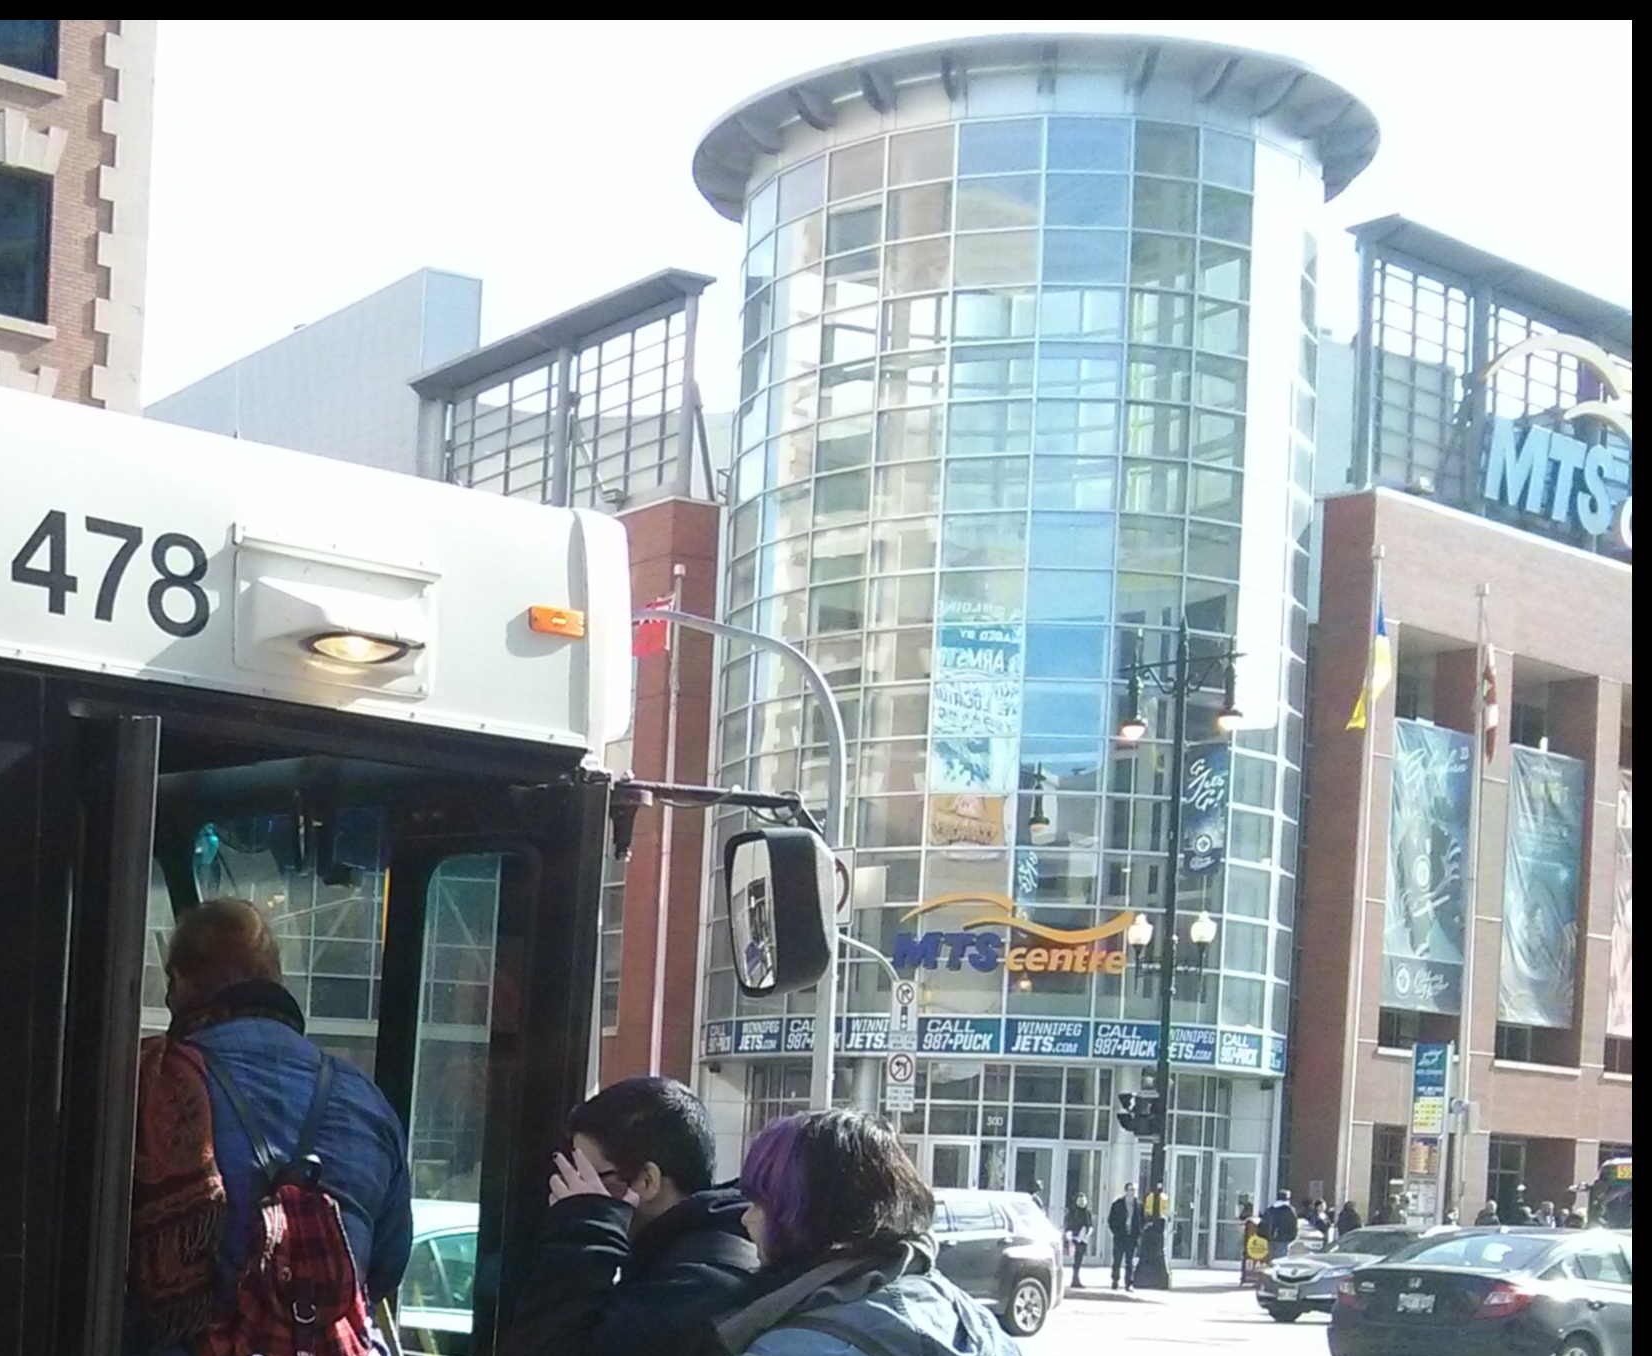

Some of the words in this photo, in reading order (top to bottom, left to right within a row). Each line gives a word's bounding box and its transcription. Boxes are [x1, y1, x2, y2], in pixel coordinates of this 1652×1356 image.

[1484, 414, 1612, 536] MTS
[10, 509, 210, 639] 478
[891, 931, 1003, 973] MTS
[1006, 944, 1127, 975] centre
[742, 1021, 780, 1034] WINNIPEG
[926, 1019, 976, 1033] CALL
[1017, 1021, 1084, 1037] WINNIPEG
[1097, 1024, 1142, 1039] CALL
[1011, 1035, 1079, 1053] JETS.COM
[1222, 1032, 1250, 1048] CALL
[1168, 1042, 1213, 1061] ETS.COM
